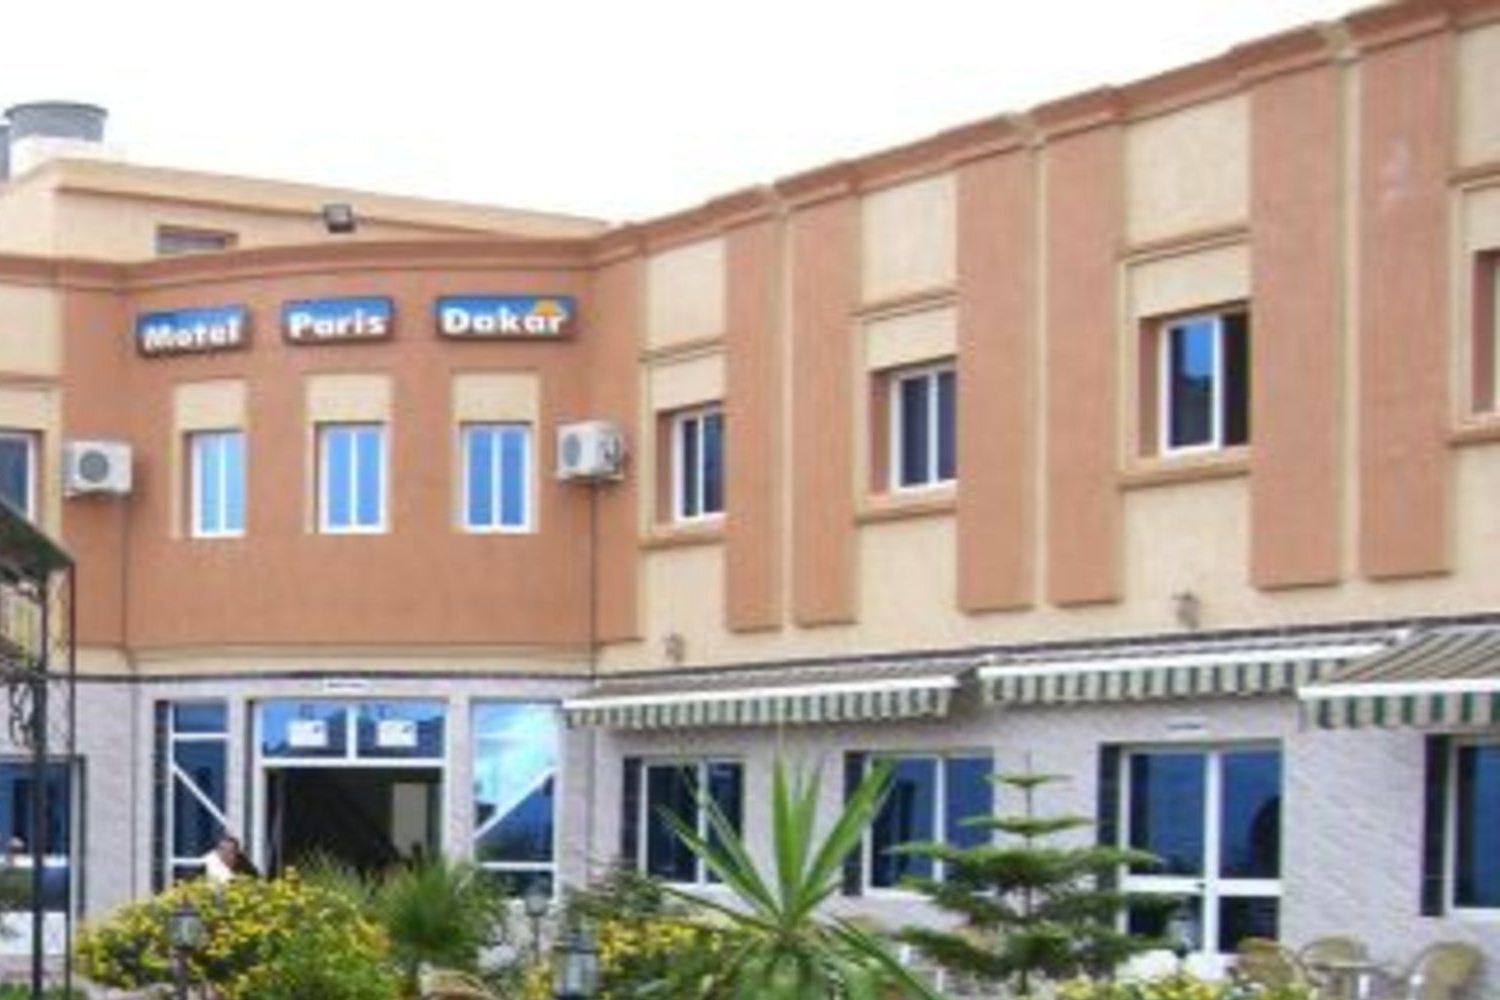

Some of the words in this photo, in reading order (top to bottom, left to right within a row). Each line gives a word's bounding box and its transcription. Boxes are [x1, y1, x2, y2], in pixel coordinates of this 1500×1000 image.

[143, 316, 240, 350] Motel
[289, 308, 386, 339] Paris
[441, 304, 566, 335] Dakar
